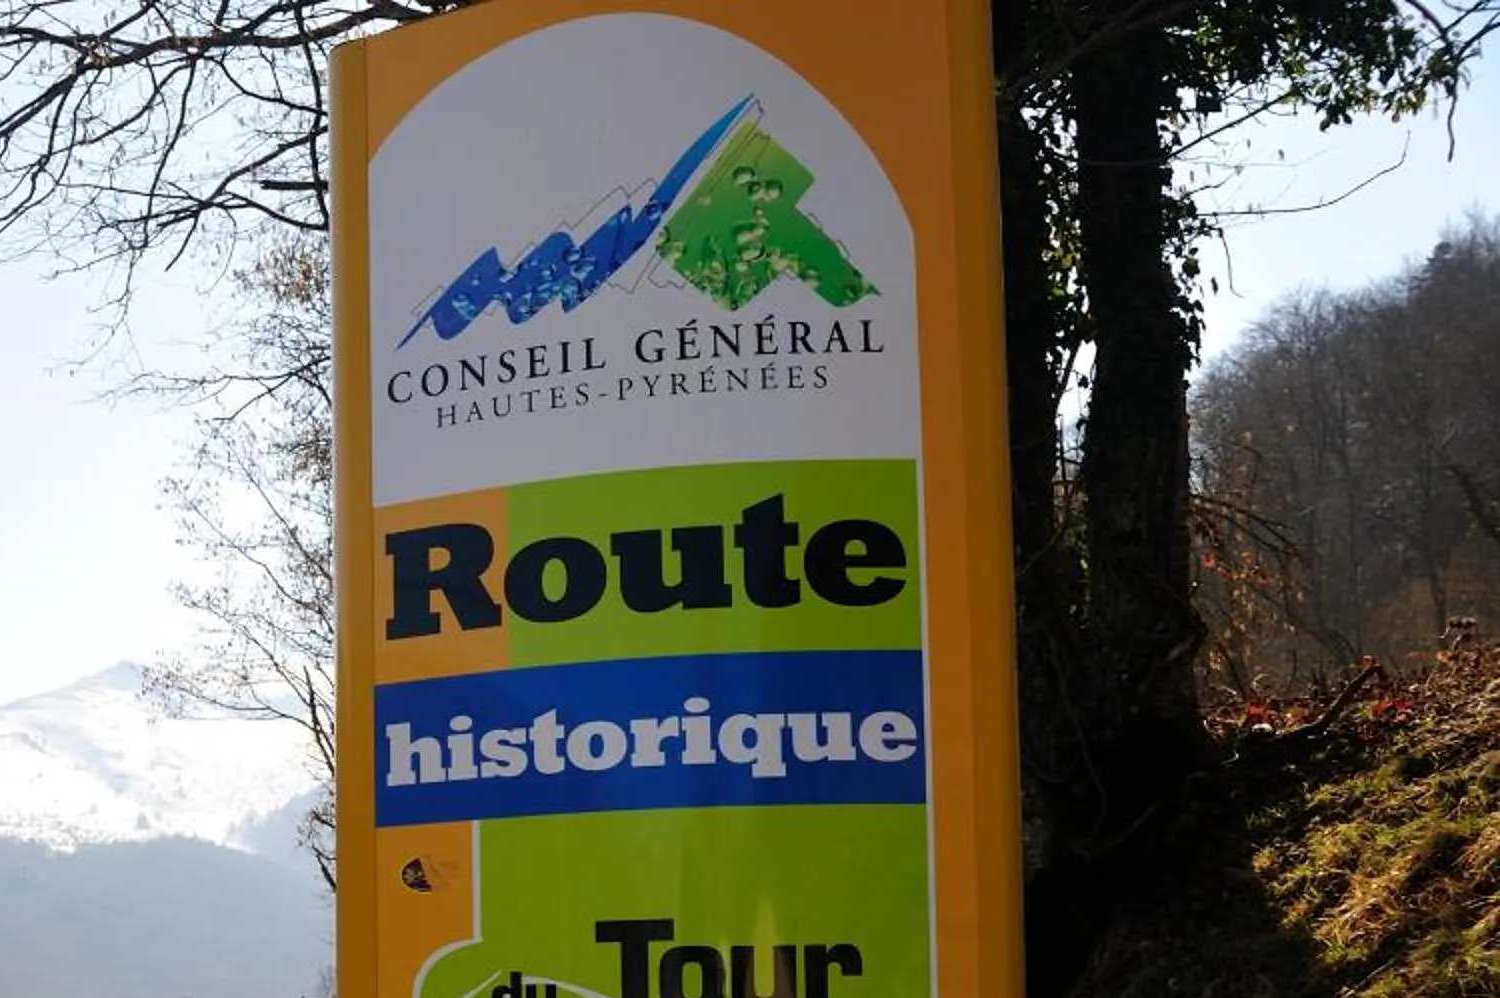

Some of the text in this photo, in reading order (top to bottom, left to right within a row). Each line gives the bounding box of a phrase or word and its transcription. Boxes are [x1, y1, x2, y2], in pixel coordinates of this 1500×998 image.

[387, 314, 885, 405] CONSEIL GÉNÉRAL
[435, 364, 830, 429] HAUTES-PYRÉNÉES
[385, 493, 907, 640] Route
[386, 697, 917, 787] historique
